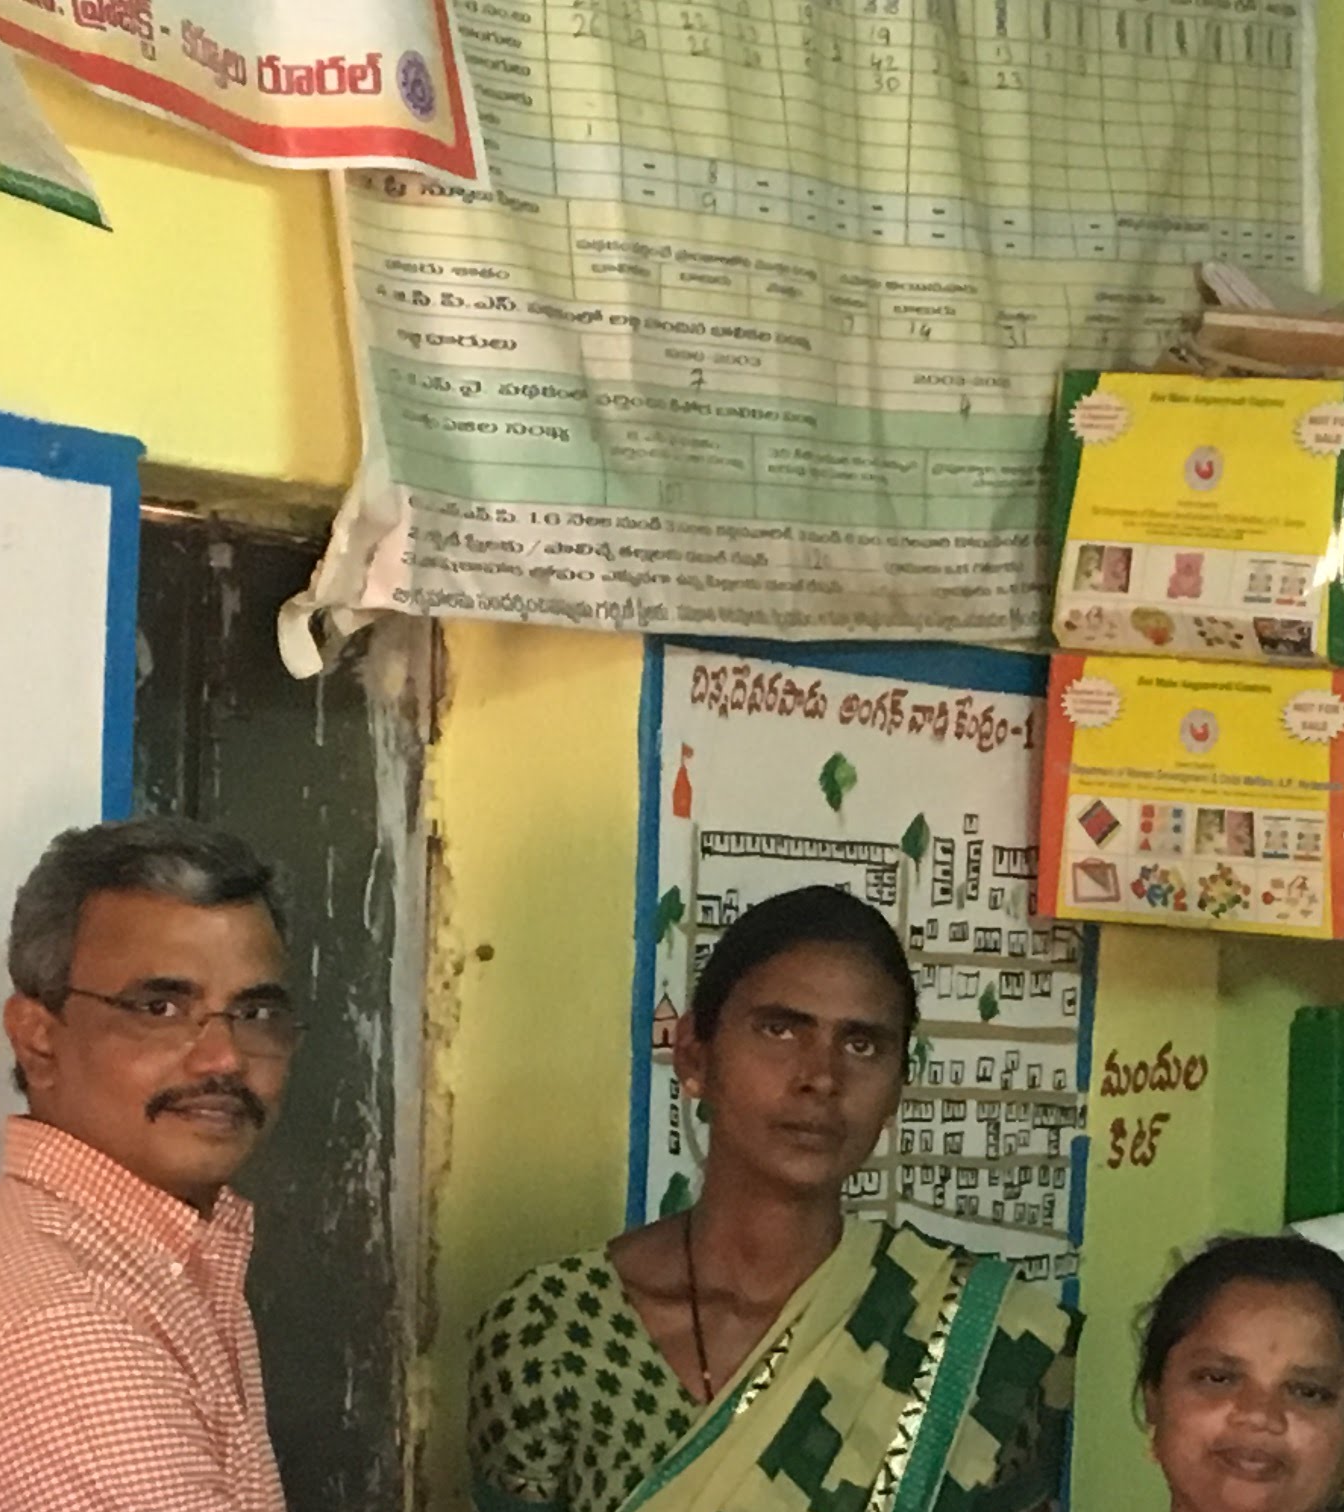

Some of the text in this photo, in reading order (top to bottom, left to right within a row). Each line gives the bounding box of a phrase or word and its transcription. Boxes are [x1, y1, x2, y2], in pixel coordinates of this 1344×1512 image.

[257, 53, 383, 96] రూరల్
[1100, 1041, 1209, 1098] మందుల
[1106, 1111, 1171, 1169] కిట్
